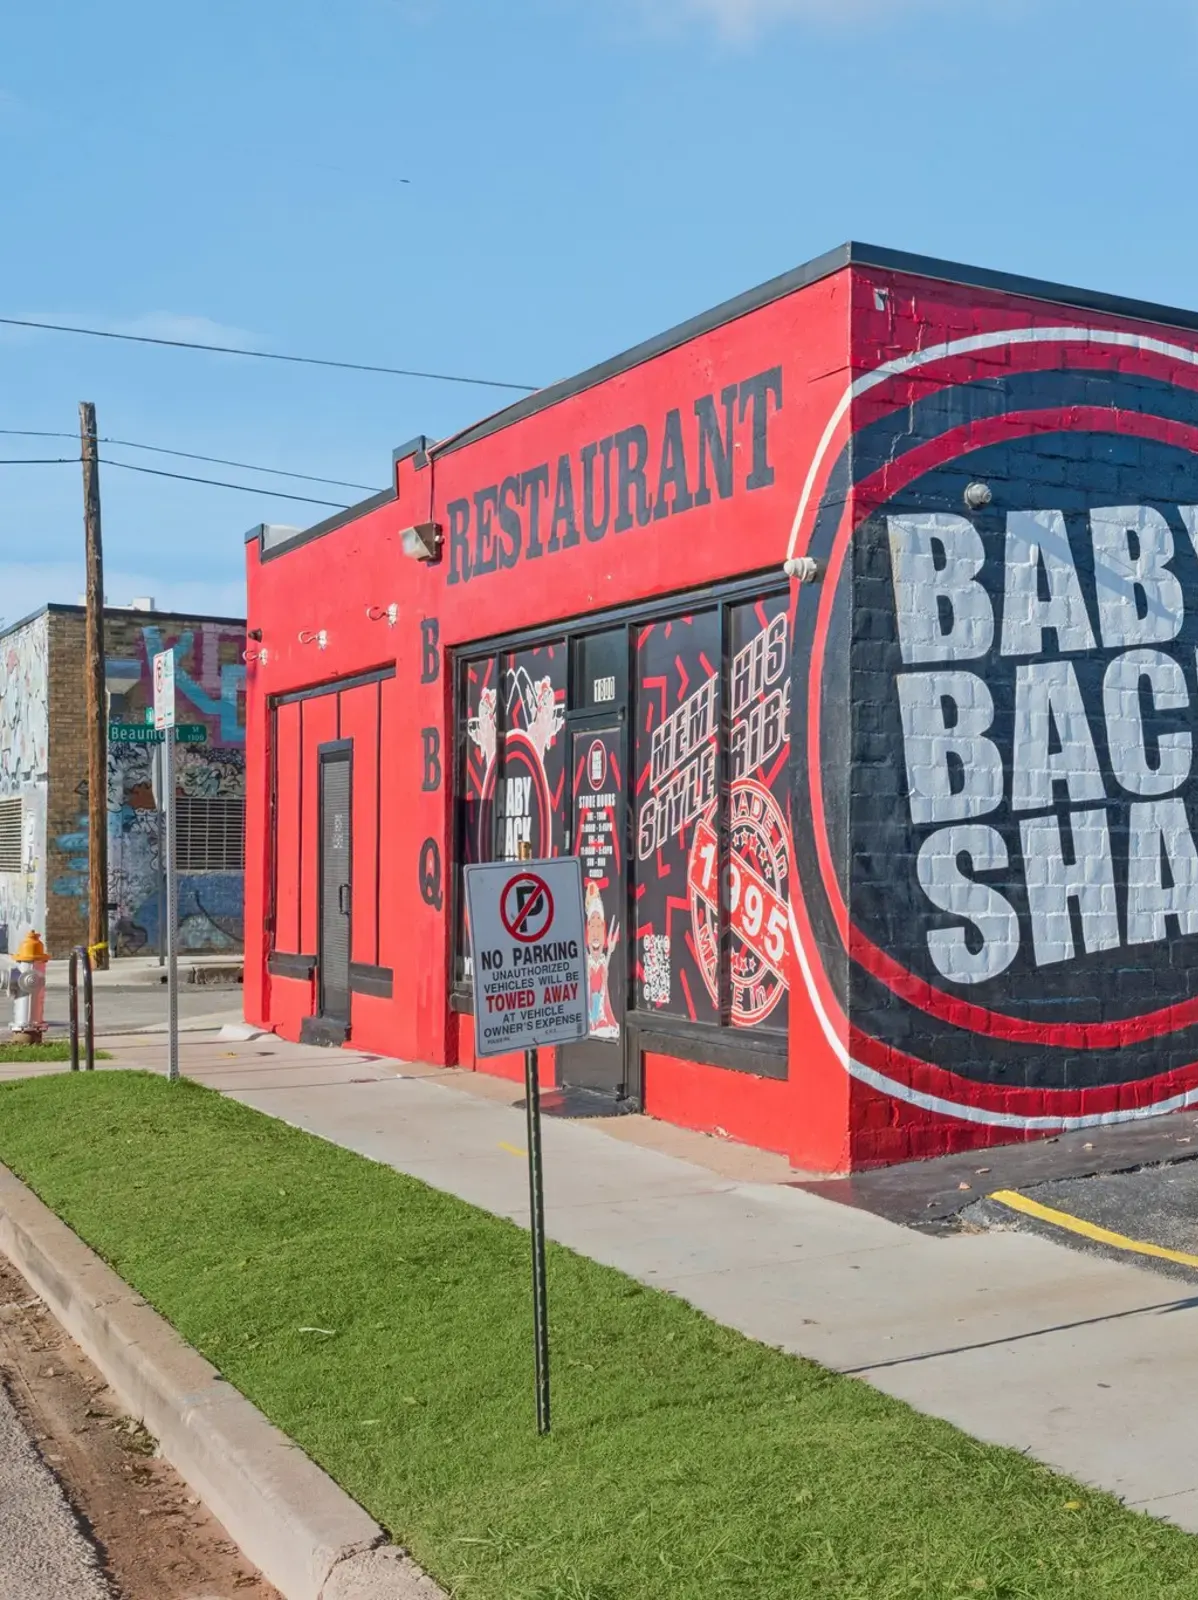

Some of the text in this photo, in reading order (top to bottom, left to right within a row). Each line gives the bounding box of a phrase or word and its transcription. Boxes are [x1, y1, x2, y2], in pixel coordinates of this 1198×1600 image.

[447, 365, 782, 586] RESTAURANT
[595, 676, 615, 701] 1800
[650, 612, 787, 790] MEMHIS
[111, 726, 180, 740] Beaumot
[700, 843, 788, 962] 1995
[481, 949, 503, 971] NO
[512, 941, 578, 967] PARKING
[484, 971, 579, 994] VEHICLES WILL BE
[492, 962, 570, 982] UNAUTHORIZED
[486, 982, 579, 1013] TOWED AWAY
[484, 1019, 533, 1038] OWNER'S
[535, 1012, 582, 1029] EXPENSE
[503, 1004, 564, 1024] AT VEHICLE
